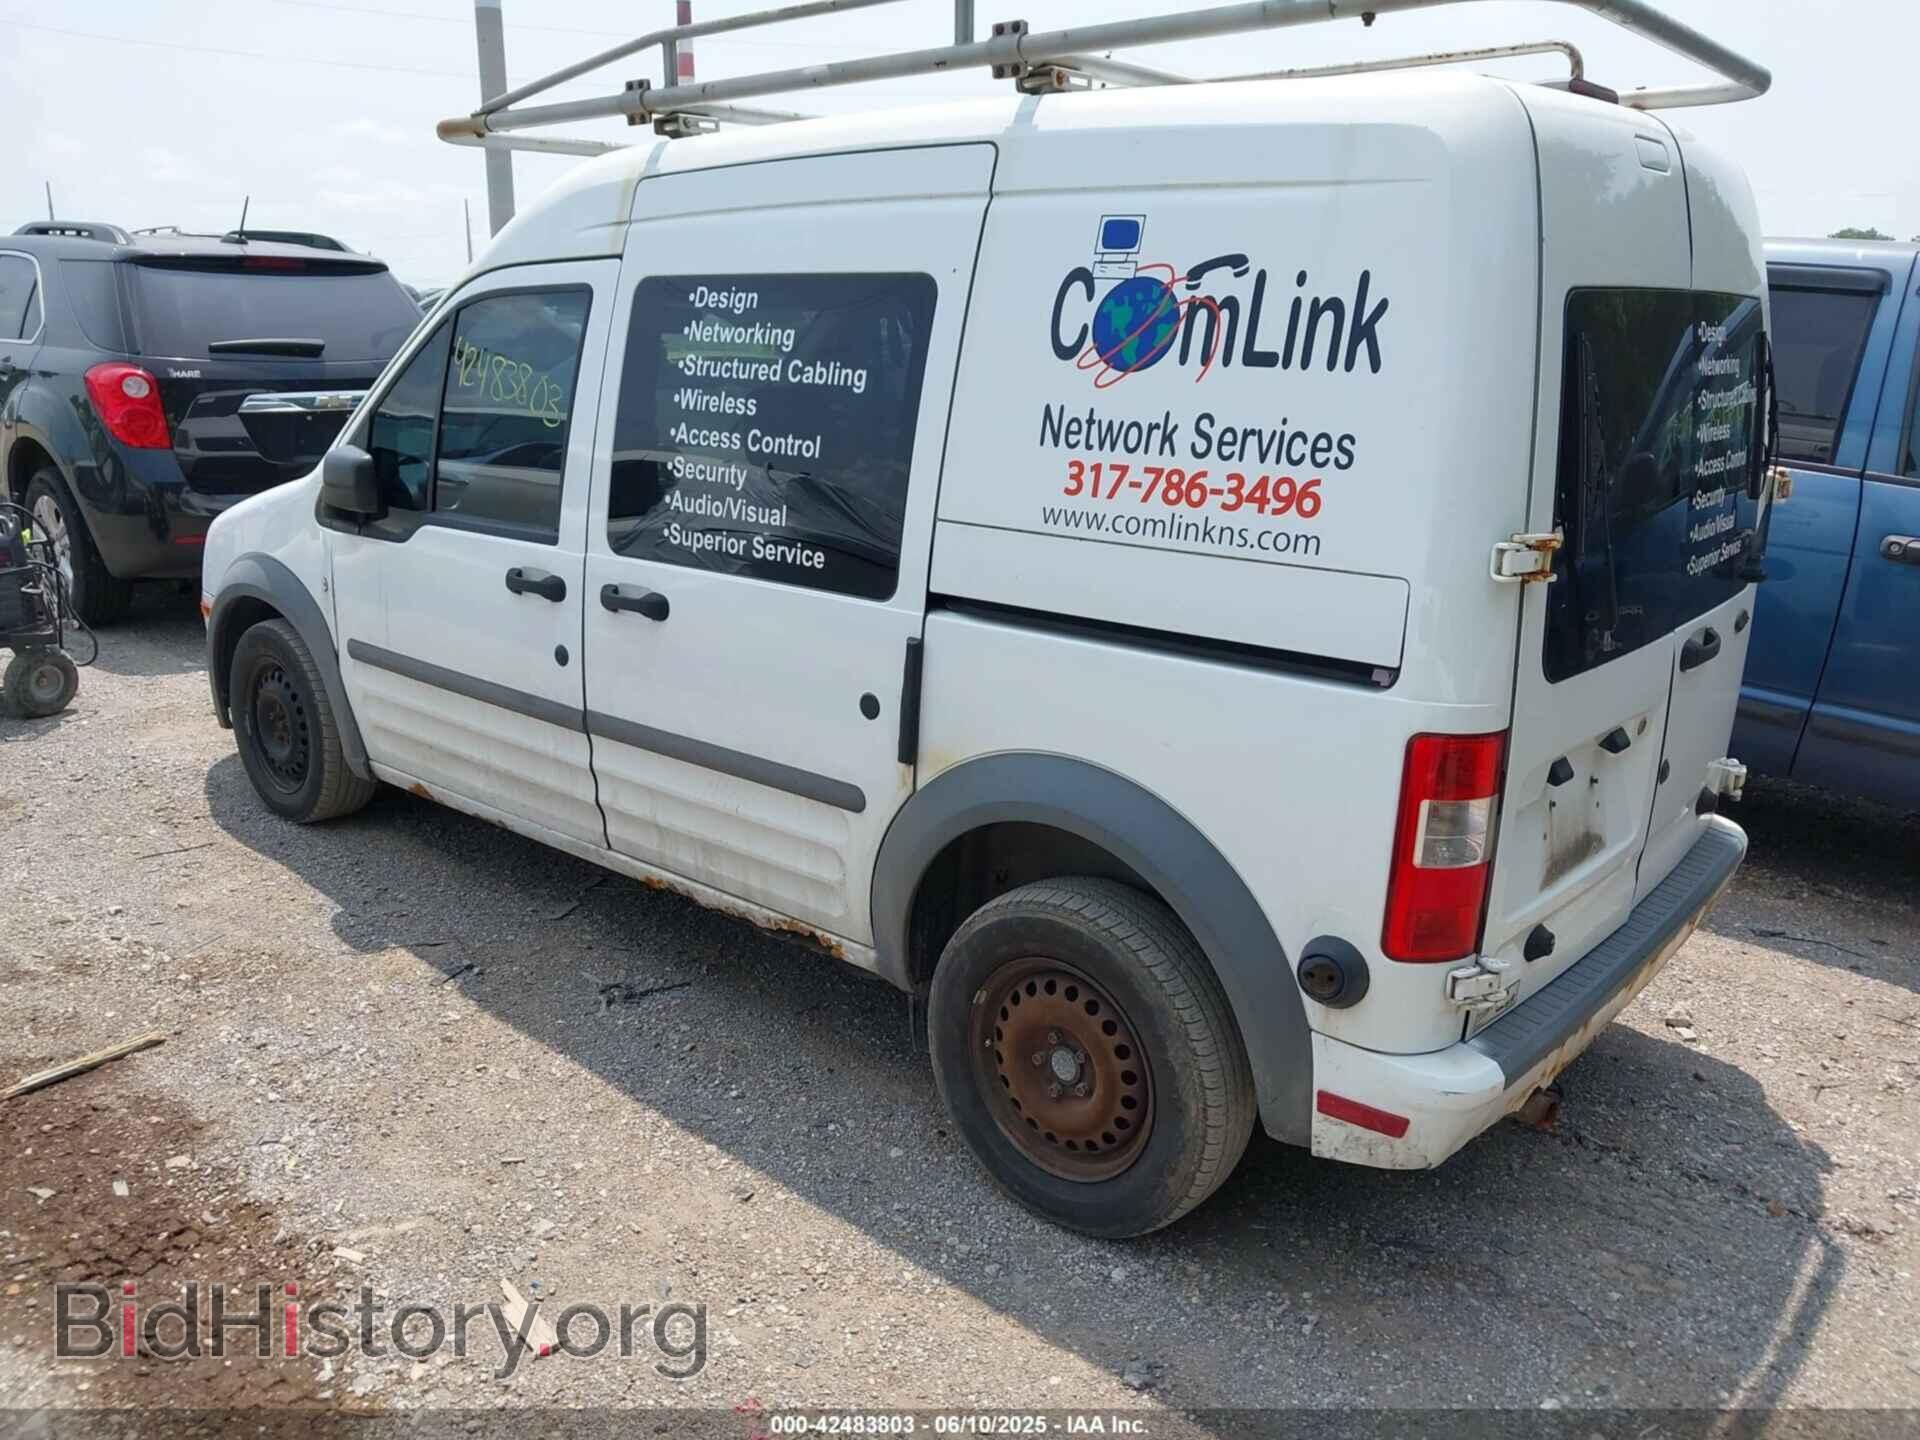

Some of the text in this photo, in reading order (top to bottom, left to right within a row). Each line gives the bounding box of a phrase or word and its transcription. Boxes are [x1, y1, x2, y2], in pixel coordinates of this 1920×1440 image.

[454, 336, 562, 429] 42483803
[787, 359, 867, 393] Cabling
[747, 428, 821, 458] Control
[1040, 403, 1356, 470] Network Services
[1063, 460, 1322, 518] 317-786-3496
[752, 537, 825, 569] Service
[1042, 505, 1321, 556] www.comlinkns.com
